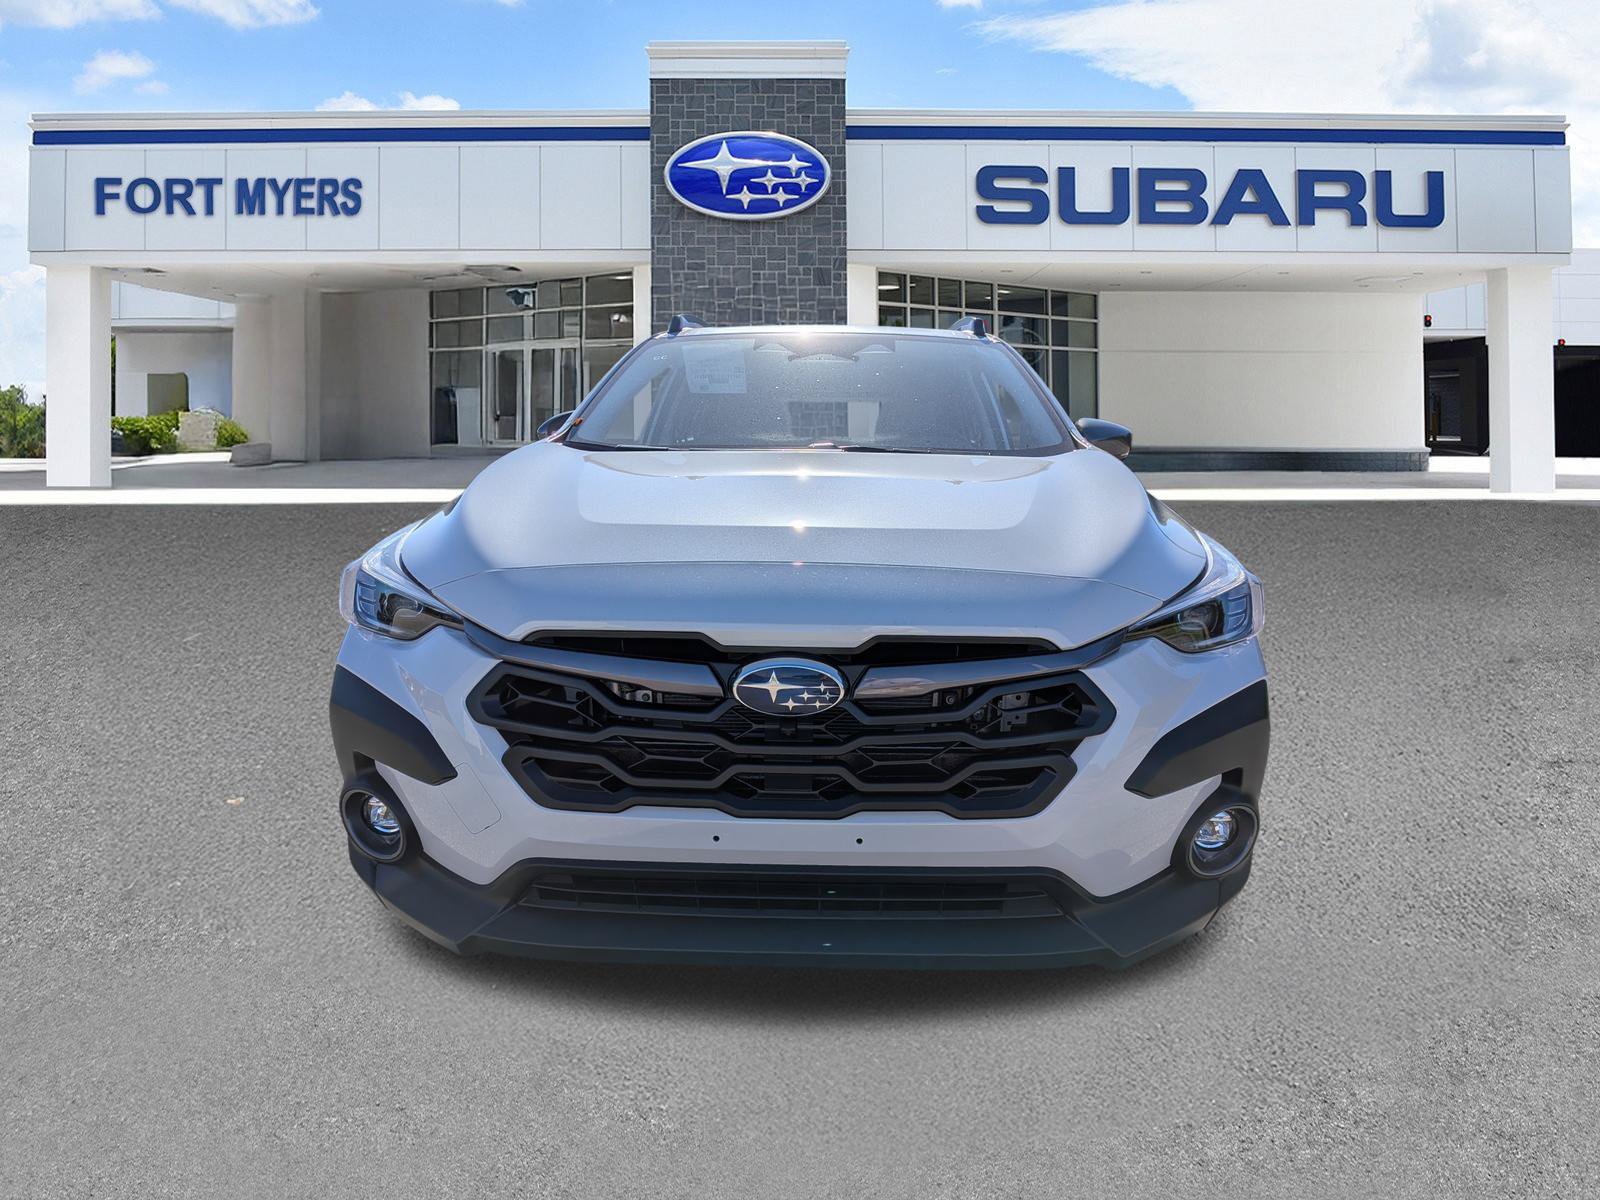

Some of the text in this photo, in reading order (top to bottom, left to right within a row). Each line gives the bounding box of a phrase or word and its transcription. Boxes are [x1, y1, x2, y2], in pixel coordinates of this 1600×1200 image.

[95, 177, 363, 216] FORT MYERS
[976, 165, 1445, 227] SUBARU
